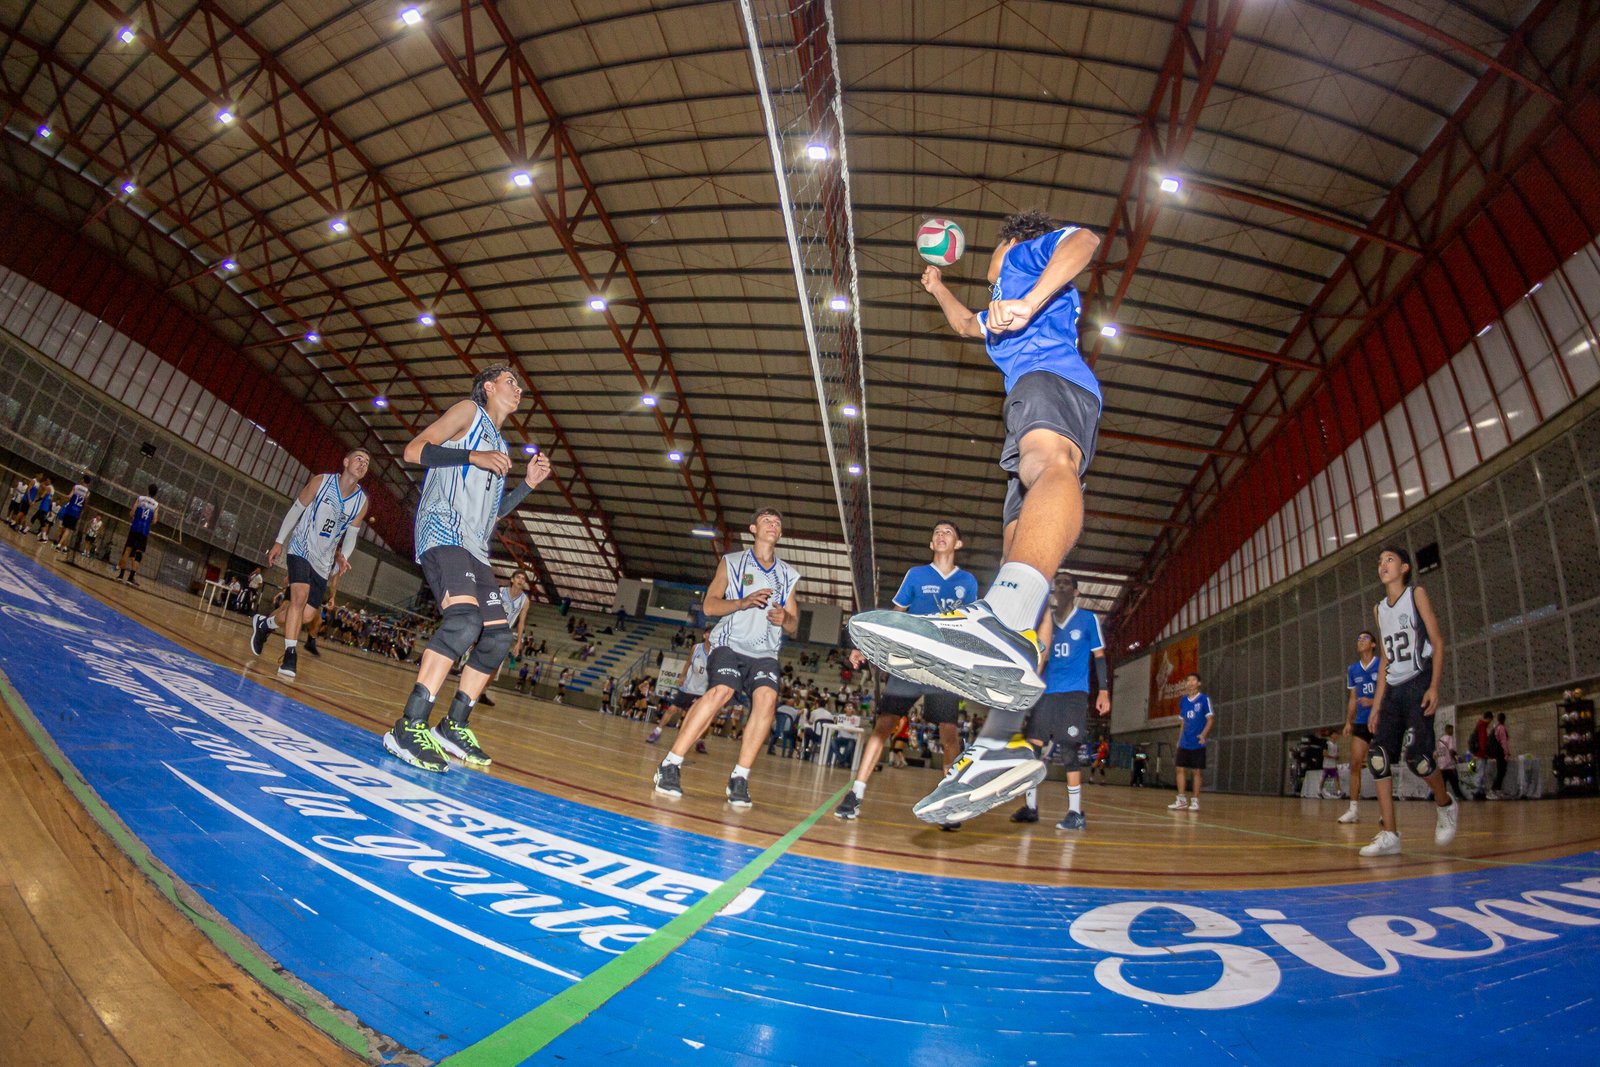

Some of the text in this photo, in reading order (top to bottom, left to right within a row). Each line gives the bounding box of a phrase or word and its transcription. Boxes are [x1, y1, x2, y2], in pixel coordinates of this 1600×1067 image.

[322, 518, 336, 533] 22
[1054, 643, 1069, 657] 50
[1384, 631, 1411, 664] 32
[1363, 682, 1374, 694] 20
[248, 728, 318, 755] de
[307, 759, 392, 788] La
[388, 798, 712, 902] Estrella
[260, 786, 368, 821] la
[312, 835, 659, 955] gente
[1069, 877, 1600, 1010] Siem
